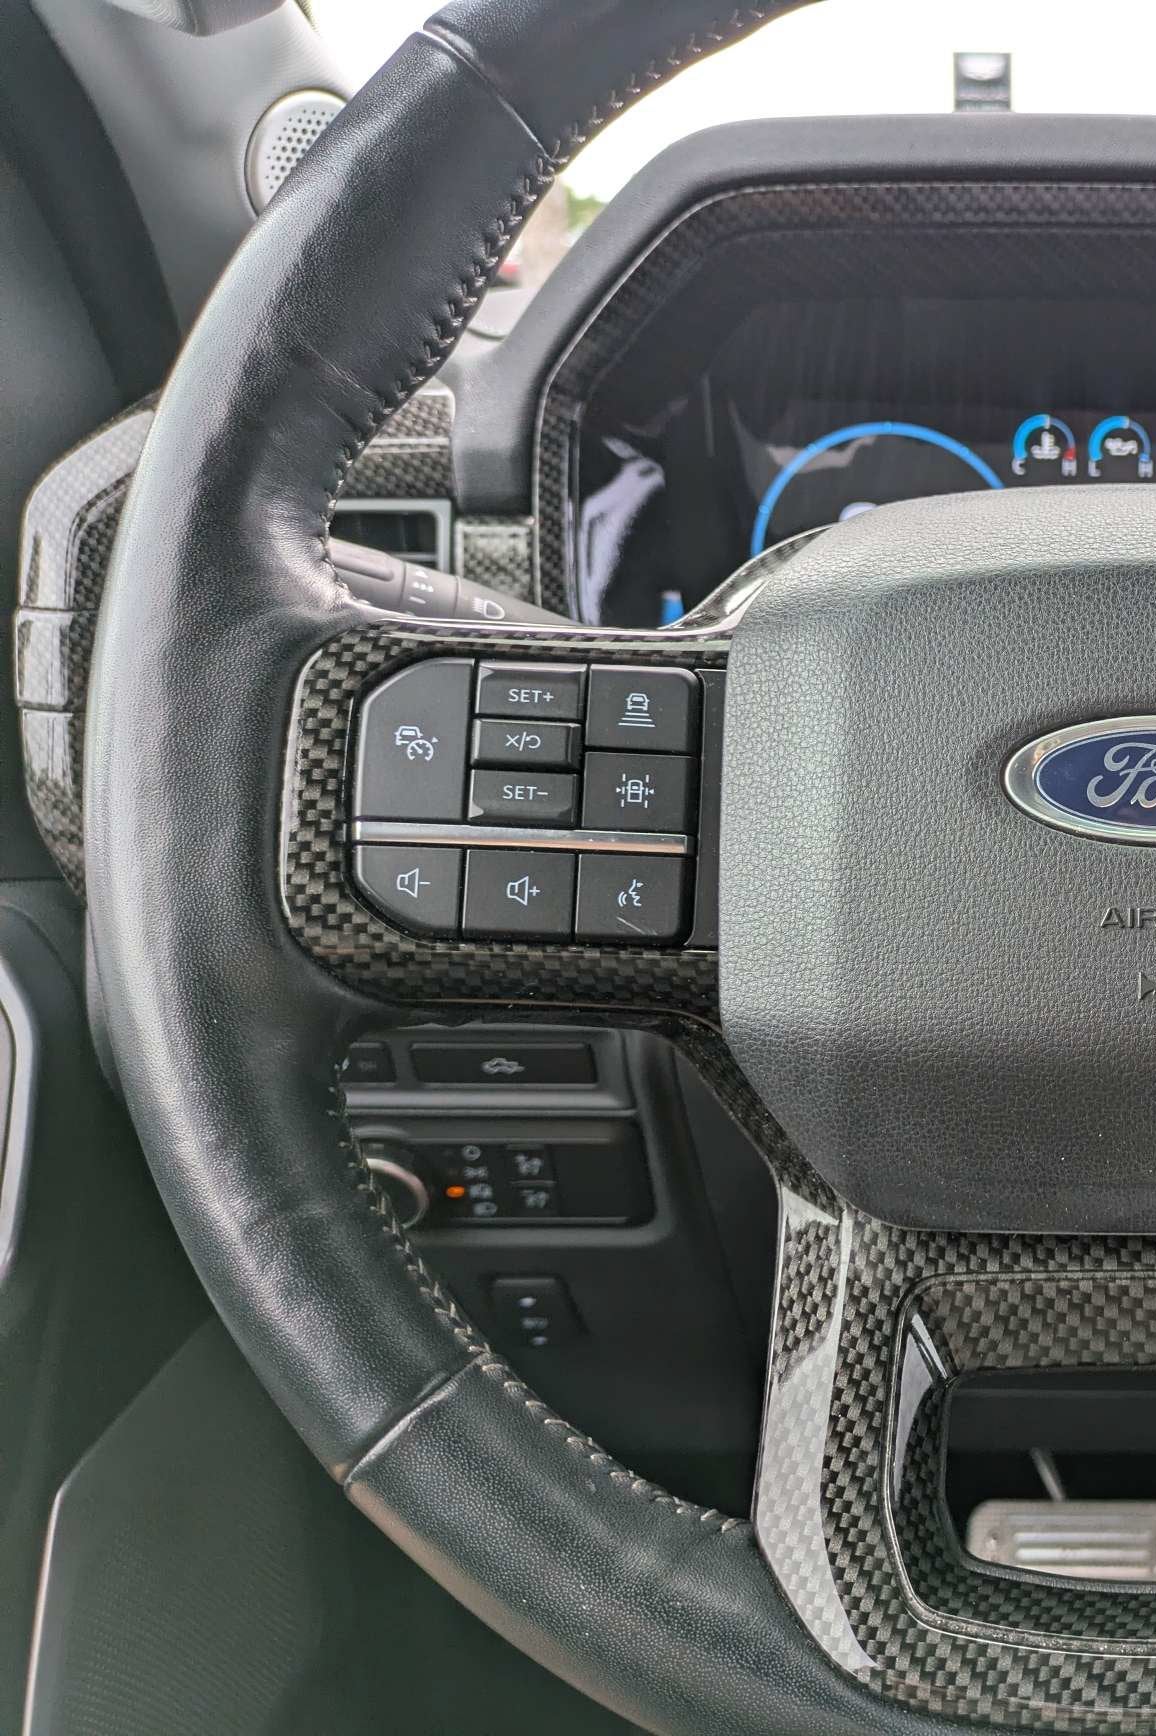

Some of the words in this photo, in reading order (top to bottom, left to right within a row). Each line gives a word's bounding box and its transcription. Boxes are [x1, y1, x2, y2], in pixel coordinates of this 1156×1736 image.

[1011, 458, 1026, 476] C
[1061, 459, 1078, 477] H
[1138, 460, 1154, 478] H
[507, 688, 555, 704] SET+
[502, 785, 550, 800] SET-
